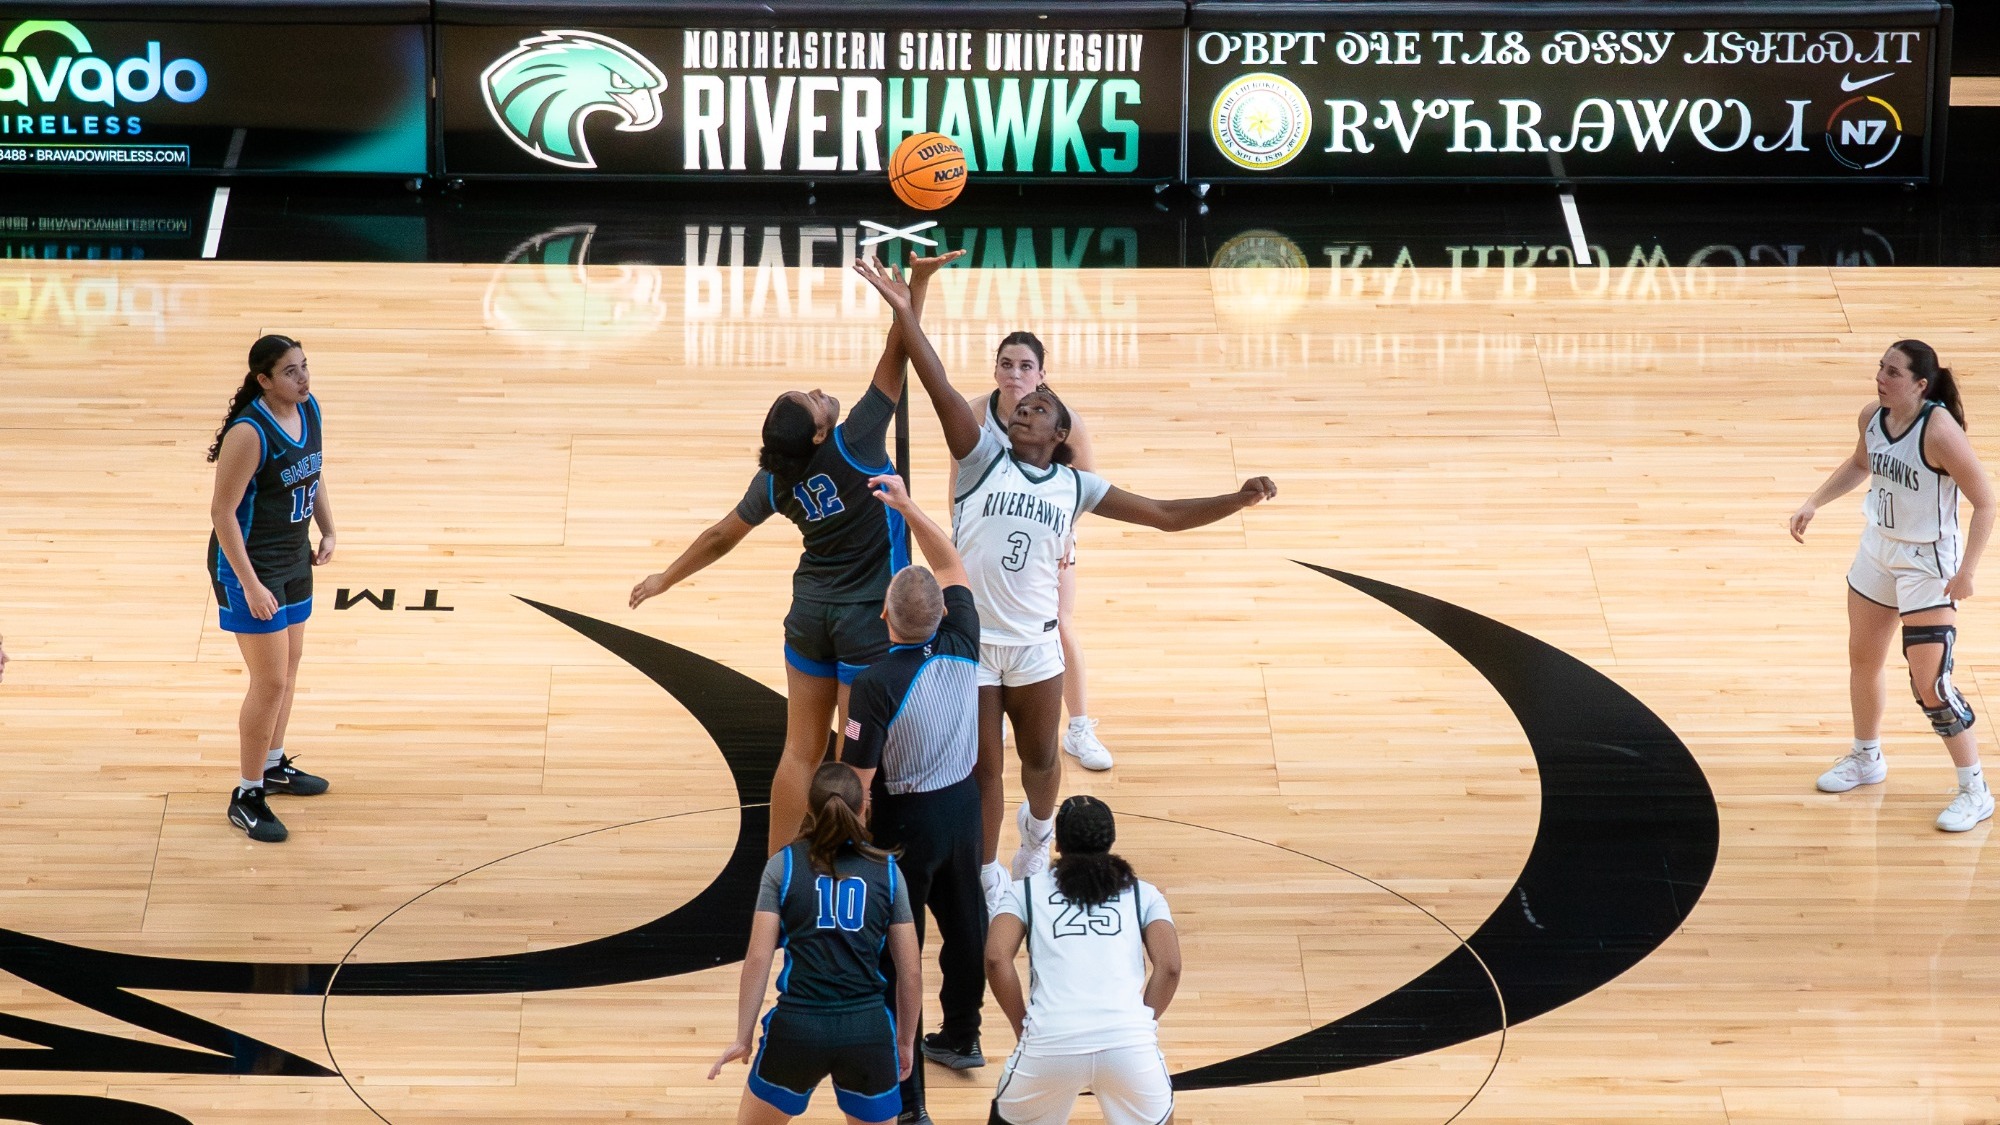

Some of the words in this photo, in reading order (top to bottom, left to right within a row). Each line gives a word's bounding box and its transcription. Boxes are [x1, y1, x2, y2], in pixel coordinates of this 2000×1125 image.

[683, 31, 886, 70] NORTHEASTERN
[899, 32, 972, 71] STATE
[986, 33, 1144, 72] UNIVERSITY
[683, 75, 1141, 172] RIVERHAWKS
[1842, 120, 1887, 145] N7
[37, 150, 185, 162] BRAVADOWIRELESS.COM
[934, 165, 964, 183] NCAA
[290, 480, 319, 523] 13
[793, 473, 845, 522] 12
[982, 491, 1065, 538] RIVERHAWKS
[1001, 528, 1031, 572] 3
[334, 588, 454, 612] TM
[815, 874, 867, 932] 10
[1048, 890, 1121, 939] 25
